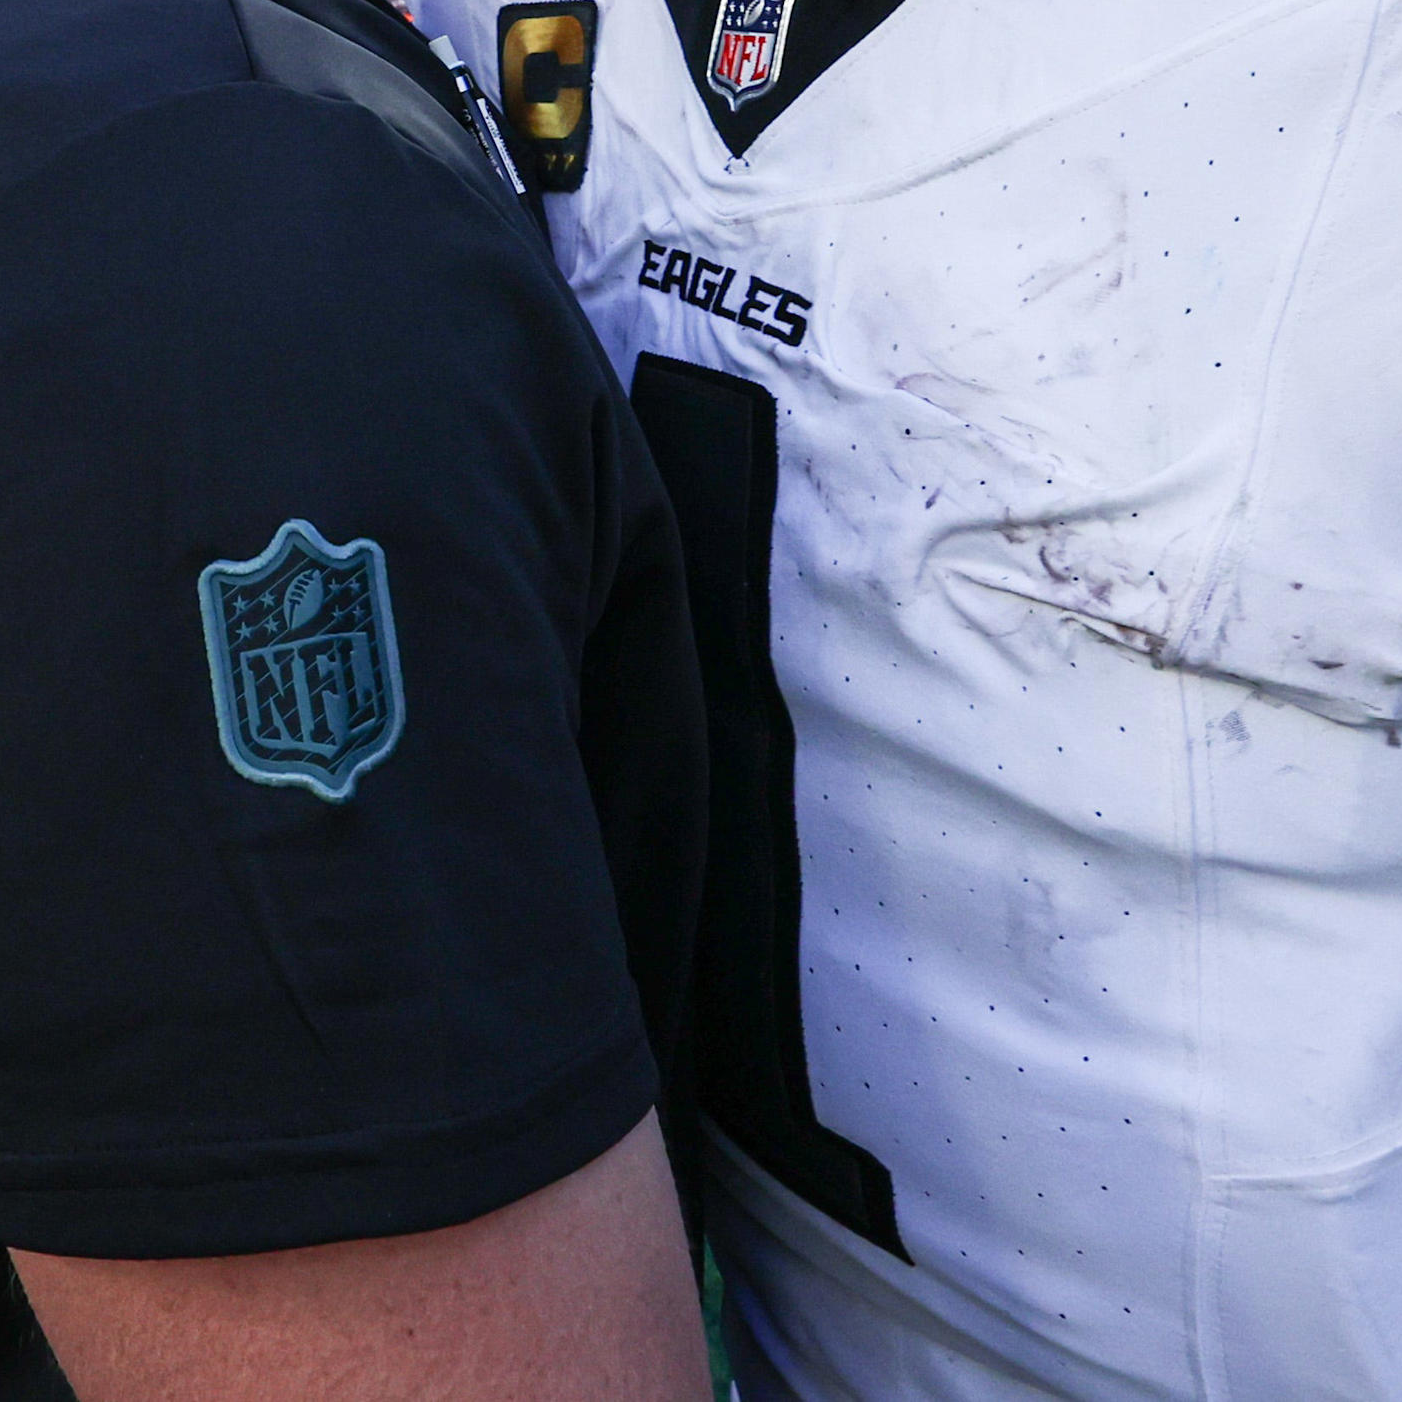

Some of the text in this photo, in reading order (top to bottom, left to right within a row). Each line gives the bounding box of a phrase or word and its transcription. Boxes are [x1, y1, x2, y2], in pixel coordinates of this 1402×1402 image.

[503, 18, 585, 139] C
[716, 34, 768, 86] NFL
[639, 240, 812, 347] EAGLES
[241, 636, 377, 758] NFL
